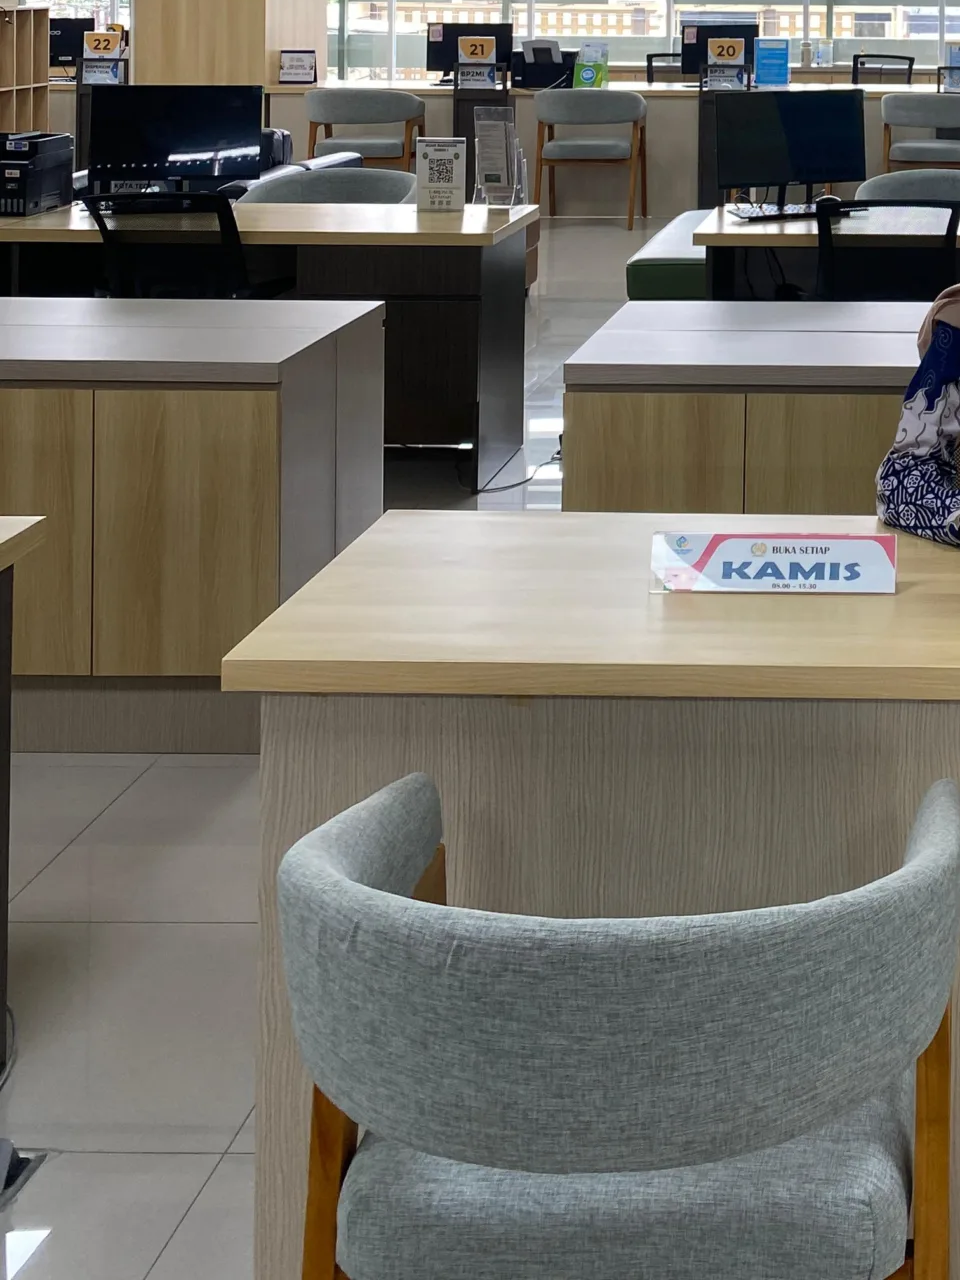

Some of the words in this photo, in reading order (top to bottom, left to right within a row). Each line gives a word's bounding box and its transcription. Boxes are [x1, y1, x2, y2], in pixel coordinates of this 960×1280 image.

[93, 38, 111, 51] 22
[469, 43, 485, 56] 21
[716, 45, 736, 57] 20
[772, 545, 797, 555] BUKA
[799, 545, 831, 555] SETIAP
[721, 561, 861, 581] KAMIS
